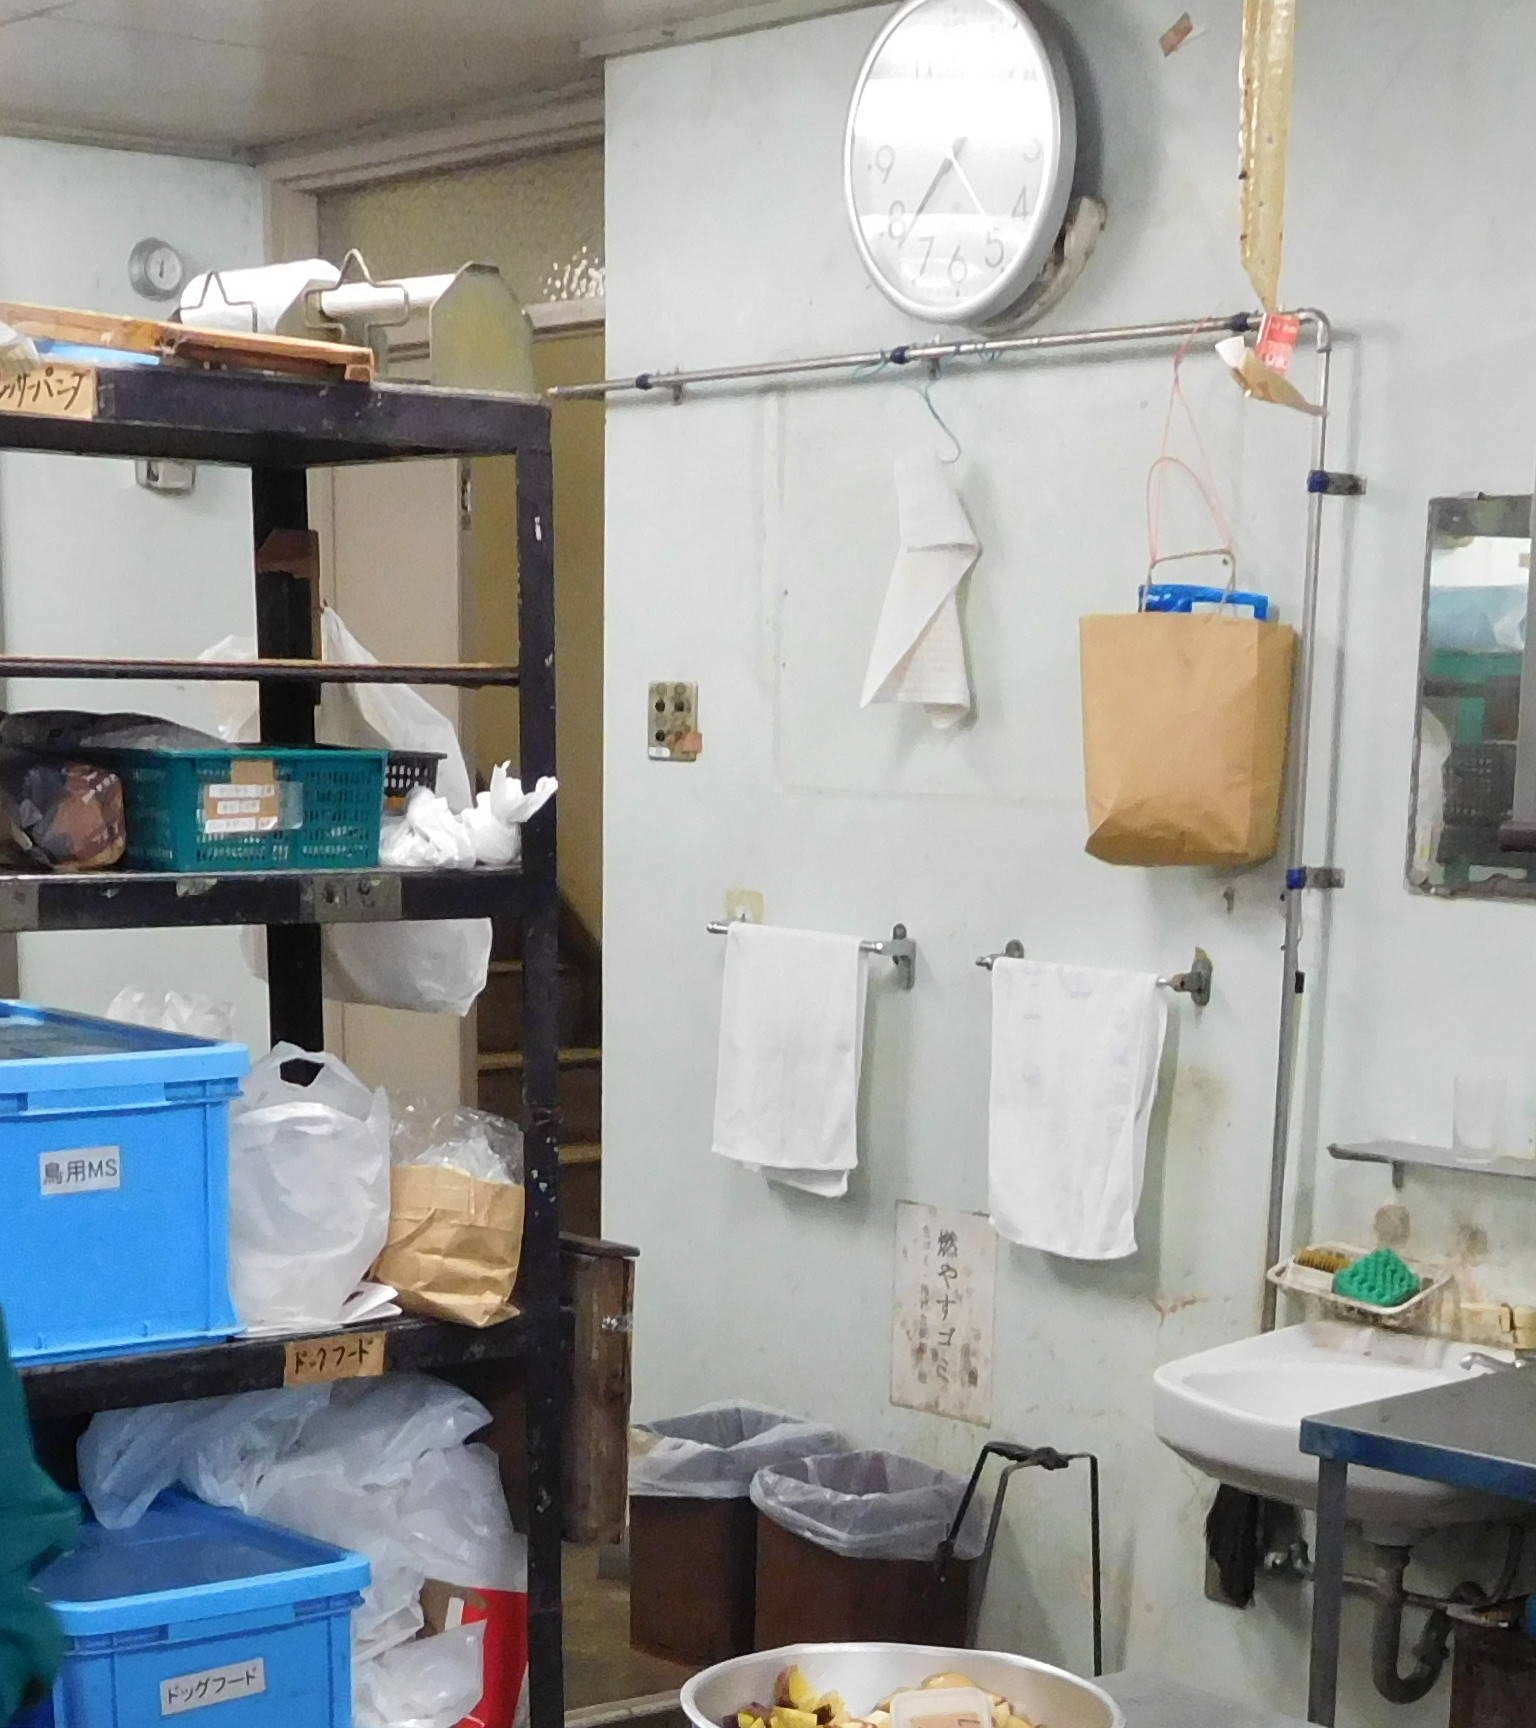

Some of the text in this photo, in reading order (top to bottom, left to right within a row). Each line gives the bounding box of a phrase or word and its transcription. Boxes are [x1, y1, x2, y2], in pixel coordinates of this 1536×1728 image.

[168, 1666, 258, 1705] ドッグフード
